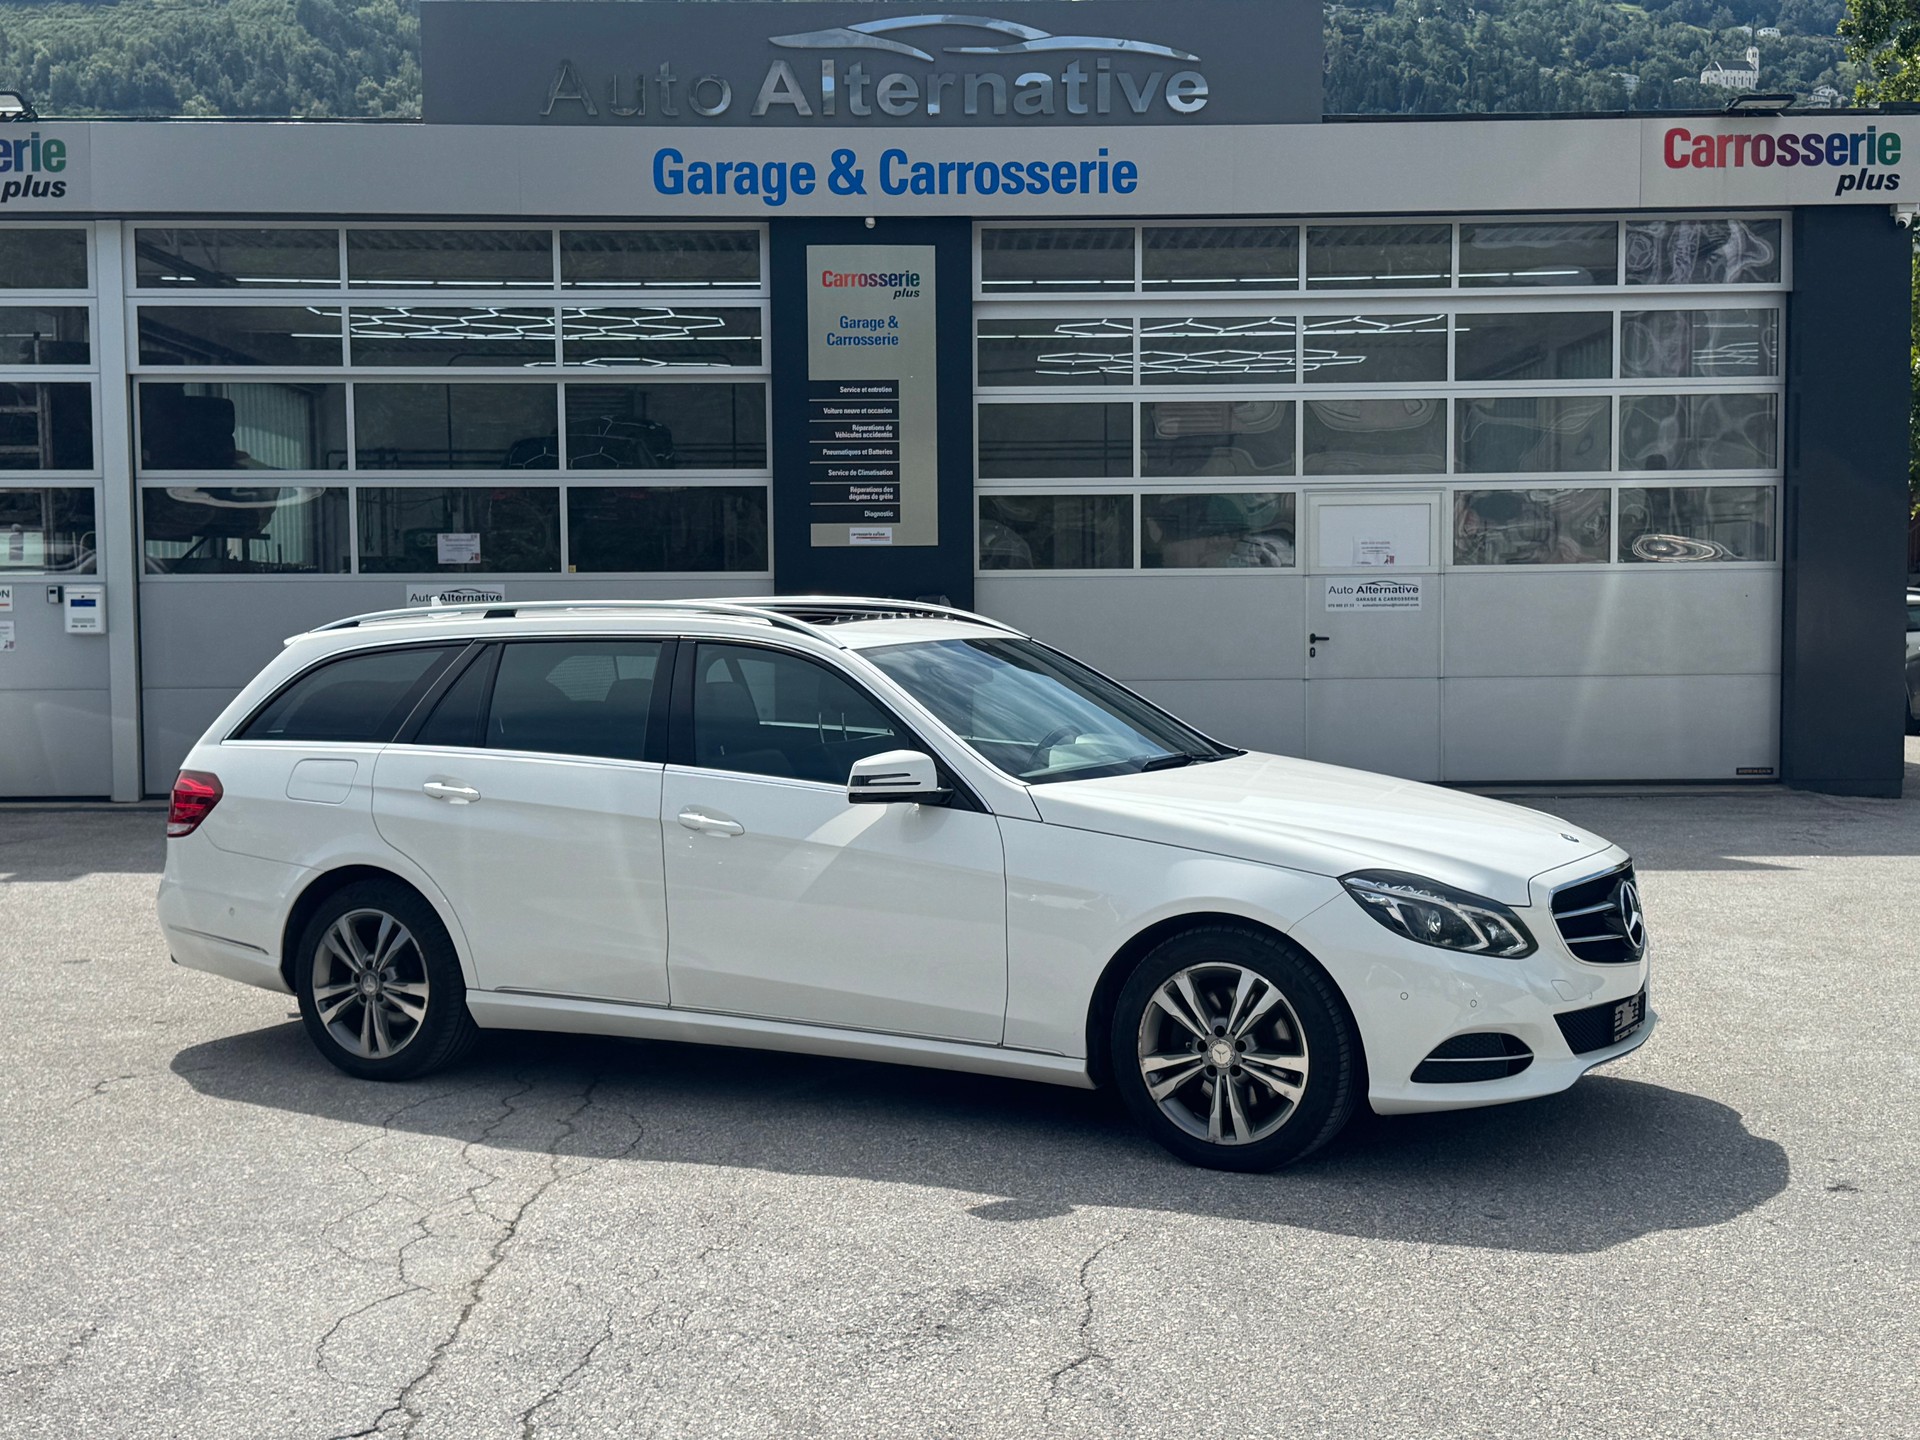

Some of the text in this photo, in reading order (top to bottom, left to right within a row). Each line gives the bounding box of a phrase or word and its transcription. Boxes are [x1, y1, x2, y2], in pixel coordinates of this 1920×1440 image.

[539, 58, 1210, 117] Auto Alternative
[1664, 125, 1901, 169] Carrosserie
[652, 147, 1138, 205] Garage & Carrosserie
[1834, 168, 1900, 197] plus
[0, 174, 67, 203] plus
[822, 270, 920, 287] Carrosserie
[893, 288, 920, 300] plus
[840, 315, 899, 331] Garage &
[826, 333, 899, 346] Carrosserie
[864, 510, 893, 518] Diagnostic
[439, 592, 502, 602] Alternative
[1328, 586, 1419, 594] Auto Alternative
